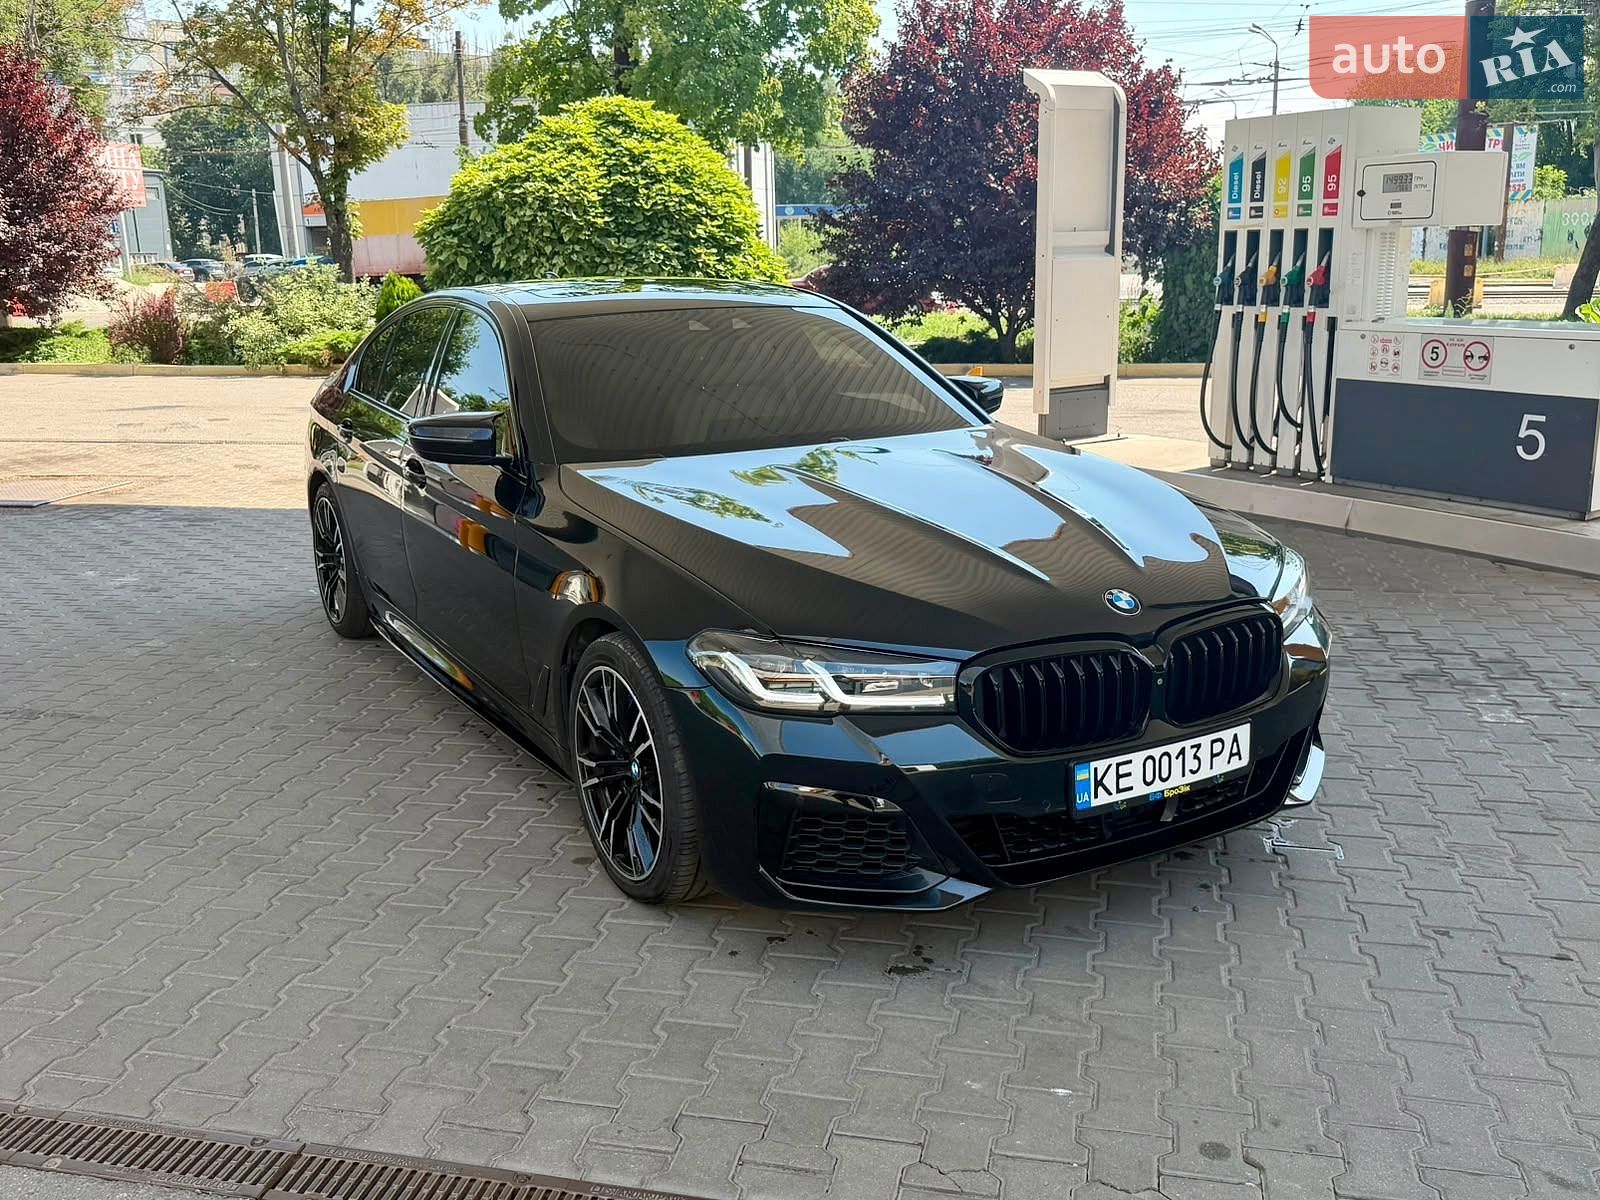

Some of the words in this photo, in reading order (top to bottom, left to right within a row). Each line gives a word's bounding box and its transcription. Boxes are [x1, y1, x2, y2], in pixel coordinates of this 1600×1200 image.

[1231, 172, 1240, 199] Diesel
[1253, 171, 1262, 199] Diesel
[1277, 178, 1287, 193] 92
[1301, 175, 1312, 192] 95
[1327, 174, 1337, 191] 95
[1430, 346, 1440, 361] 5
[1515, 413, 1547, 461] 5
[1092, 760, 1134, 800] KE
[1142, 742, 1202, 787] 0013
[1209, 733, 1243, 771] PA
[1075, 792, 1090, 804] UA
